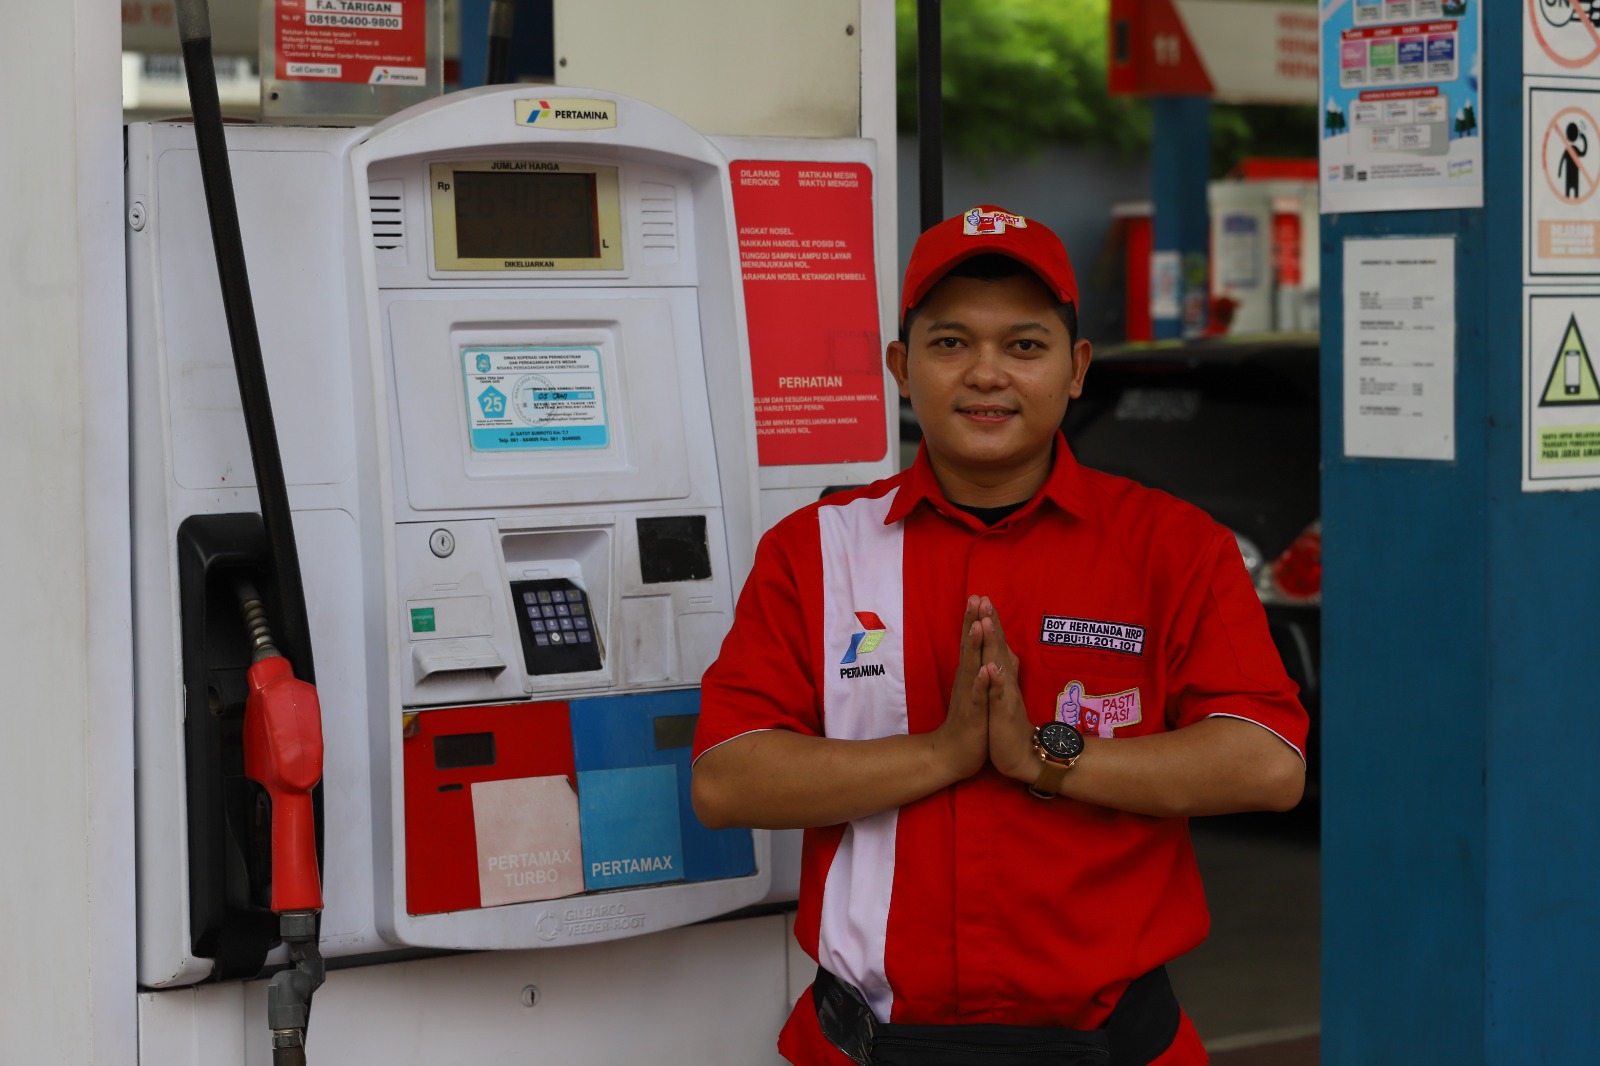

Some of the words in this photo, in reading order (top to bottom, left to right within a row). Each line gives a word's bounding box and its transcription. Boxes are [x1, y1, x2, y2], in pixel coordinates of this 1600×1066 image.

[341, 2, 392, 13] TARIGAN
[309, 14, 399, 28] 0818-0400-9800
[291, 65, 302, 73] Call
[304, 66, 325, 74] Center
[555, 110, 609, 121] PERTAMINA
[491, 161, 527, 171] JUMLAH
[528, 162, 560, 171] HARGA
[740, 170, 780, 178] DILARANG
[798, 171, 832, 179] MATIKAN
[833, 172, 857, 180] MESIN
[437, 181, 451, 192] Rp
[740, 178, 780, 187] MEROKOK
[798, 179, 826, 187] WAKTU
[827, 180, 858, 188] MENGISI
[740, 227, 768, 235] ANGKAT
[602, 239, 609, 249] L
[740, 239, 771, 247] NAIKKAN
[772, 240, 800, 248] HANDEL
[801, 240, 810, 248] KE
[812, 240, 834, 248] POSISI
[741, 252, 770, 260] TUNGGU
[771, 252, 797, 260] SAMPAI
[798, 252, 821, 260] LAMPU
[822, 252, 830, 260] DI
[830, 252, 852, 260] LAYAR
[504, 260, 555, 269] DIKELUARKAN
[741, 260, 794, 269] MENUNJUKKAN
[742, 273, 777, 281] ARAHKAN
[777, 273, 801, 281] NOSEL
[801, 273, 836, 281] KETANGKI
[779, 376, 843, 389] PERHATIAN
[483, 396, 503, 413] 25
[771, 396, 784, 404] DAN
[784, 396, 813, 404] SESUDAH
[813, 395, 856, 403] PENGELUARAN
[784, 404, 803, 412] TETAP
[772, 419, 795, 427] MINYAK
[795, 418, 837, 426] DIKELUARKAN
[837, 417, 858, 425] ANGKA
[776, 427, 797, 435] HARUS
[1046, 619, 1067, 631] BOY
[1069, 621, 1123, 637] HERNANDA
[1124, 628, 1142, 640] HRP
[1047, 632, 1136, 652] SPBU:11.201.101
[840, 664, 885, 679] PERTAMINA
[1101, 692, 1135, 712] PASTI
[488, 849, 572, 872] PERTAMAX
[592, 855, 673, 878] PERTAMAX
[504, 867, 558, 888] TURBO
[565, 903, 626, 922] GILBARCO
[567, 916, 647, 937] VEEDER-ROOT
